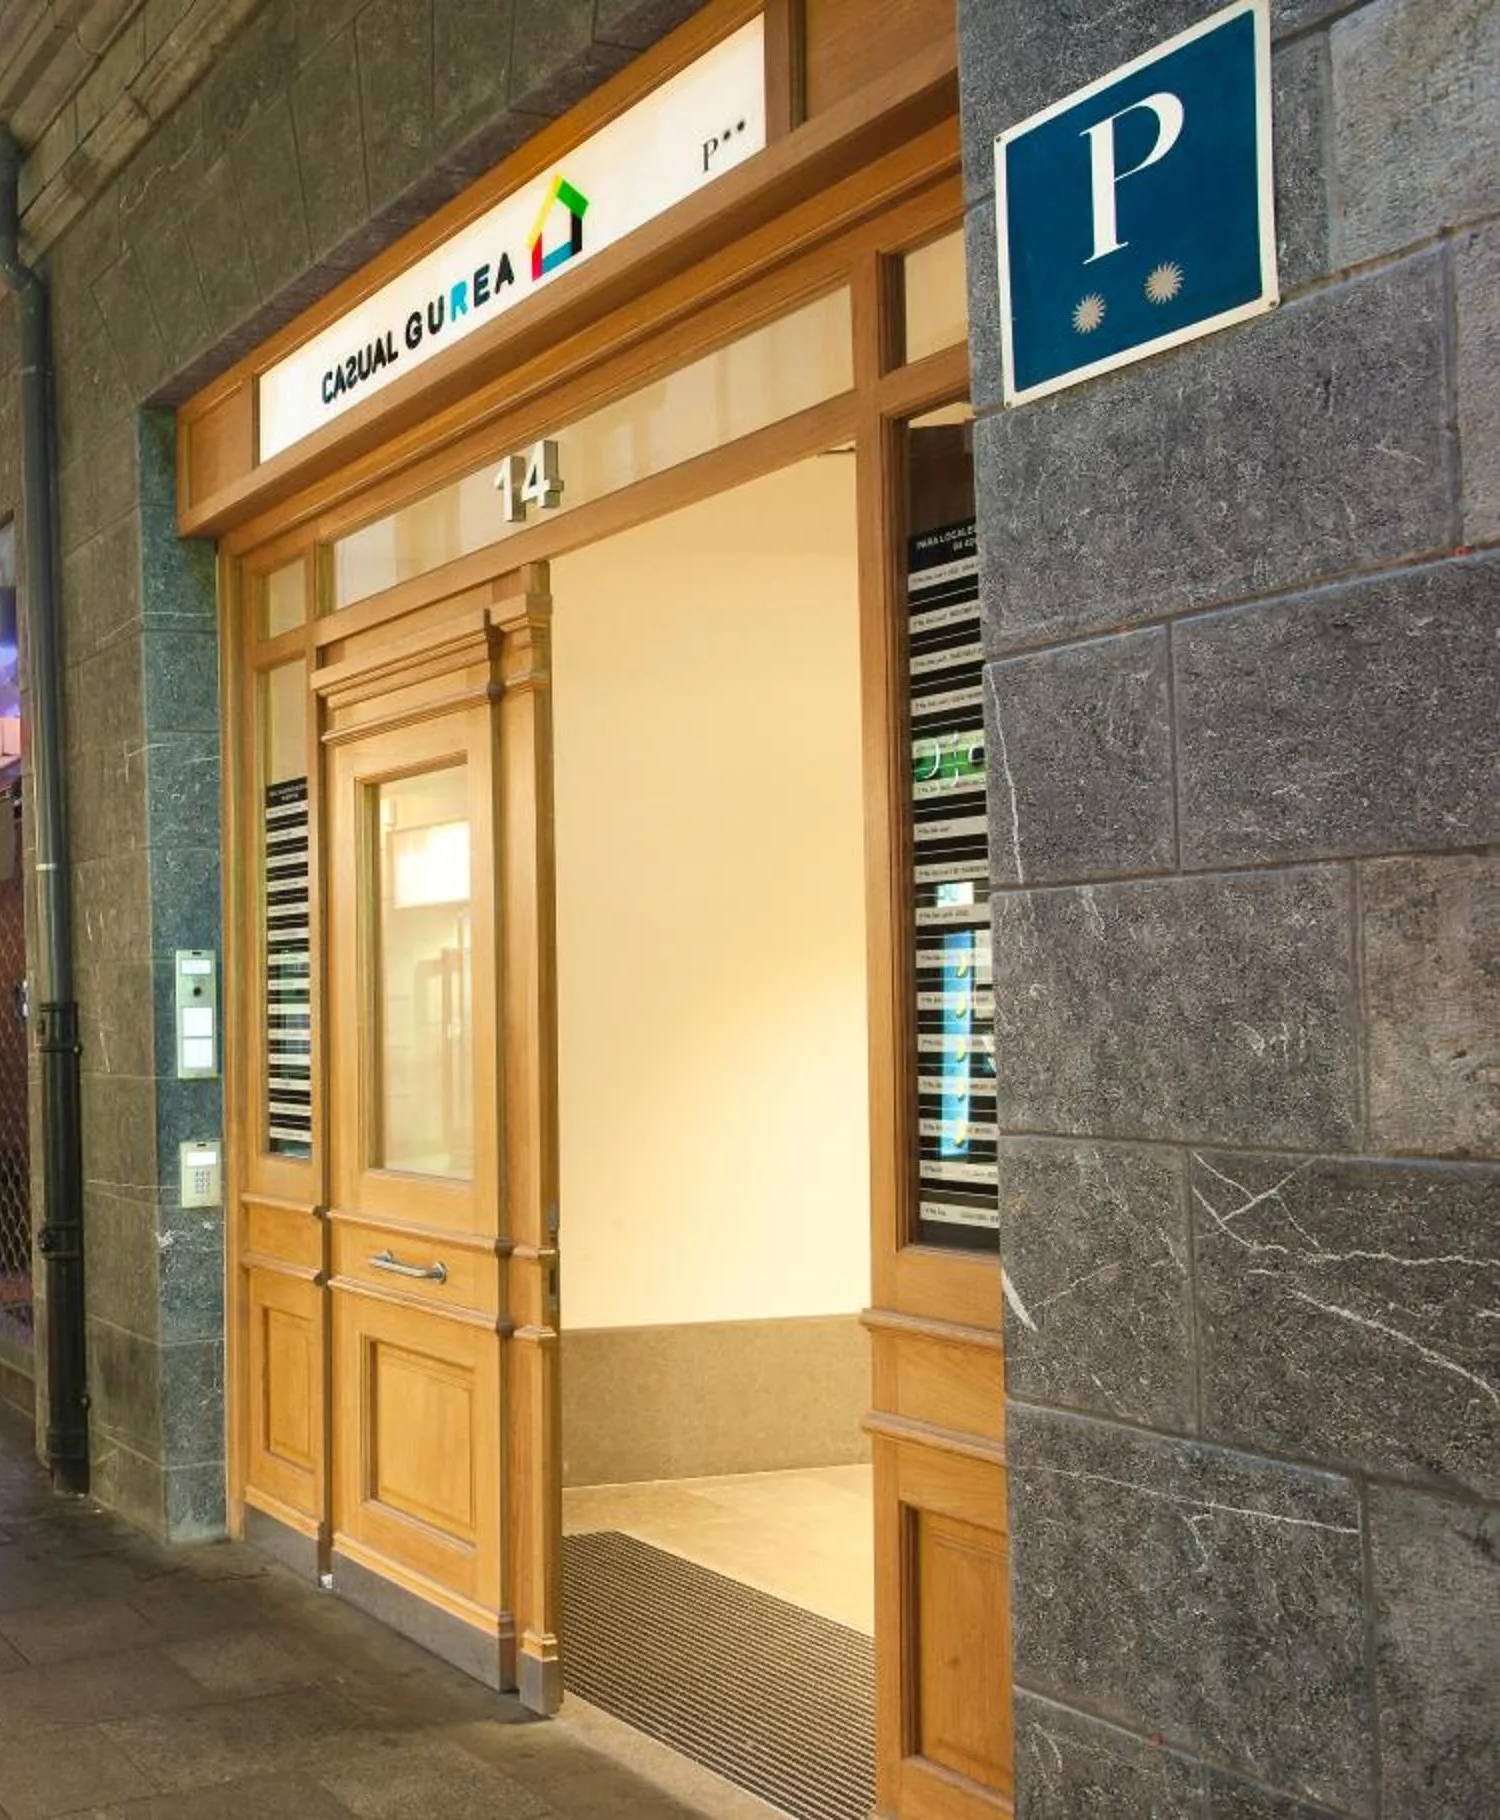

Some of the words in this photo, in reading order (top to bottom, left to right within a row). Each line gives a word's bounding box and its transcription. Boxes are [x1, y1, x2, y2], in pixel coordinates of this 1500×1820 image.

[1080, 91, 1185, 266] P
[322, 332, 399, 404] CASUAL
[405, 252, 514, 350] GUREA
[495, 440, 562, 522] 14
